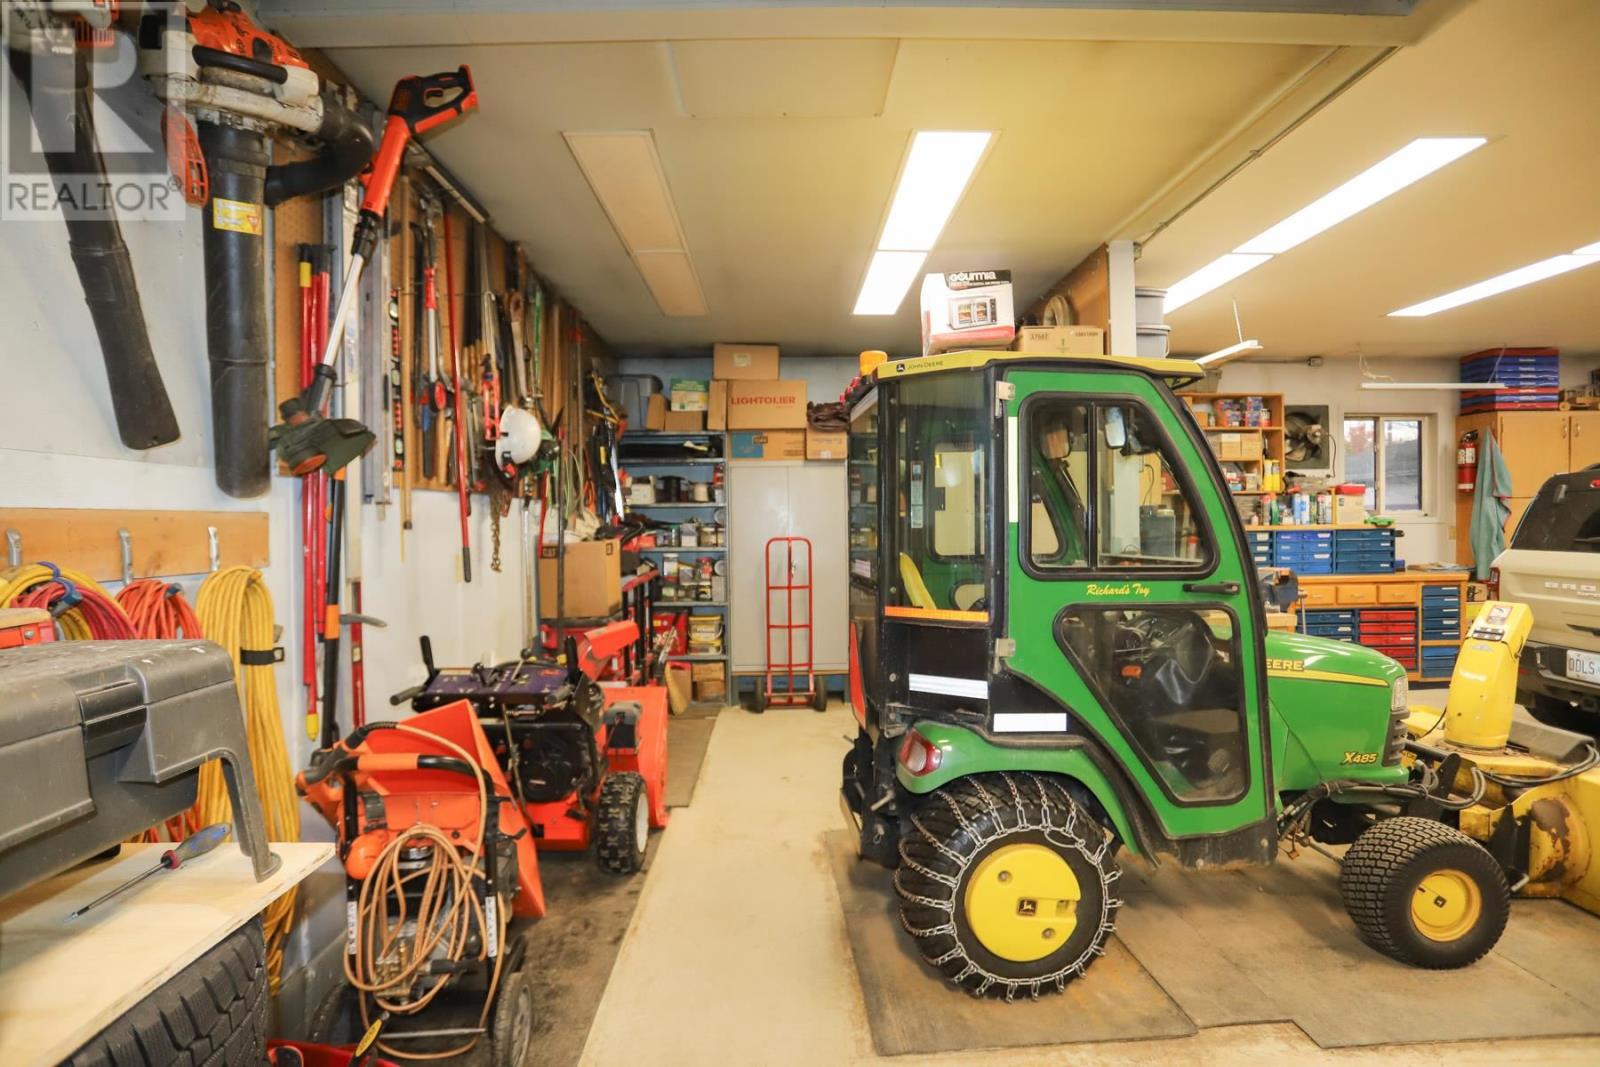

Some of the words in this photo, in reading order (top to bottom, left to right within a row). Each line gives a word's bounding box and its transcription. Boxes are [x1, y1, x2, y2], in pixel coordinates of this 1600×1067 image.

[730, 396, 796, 405] LIGHTOLIER
[1132, 583, 1150, 598] Toy
[1266, 658, 1304, 671] EERE
[1342, 752, 1377, 764] X485
